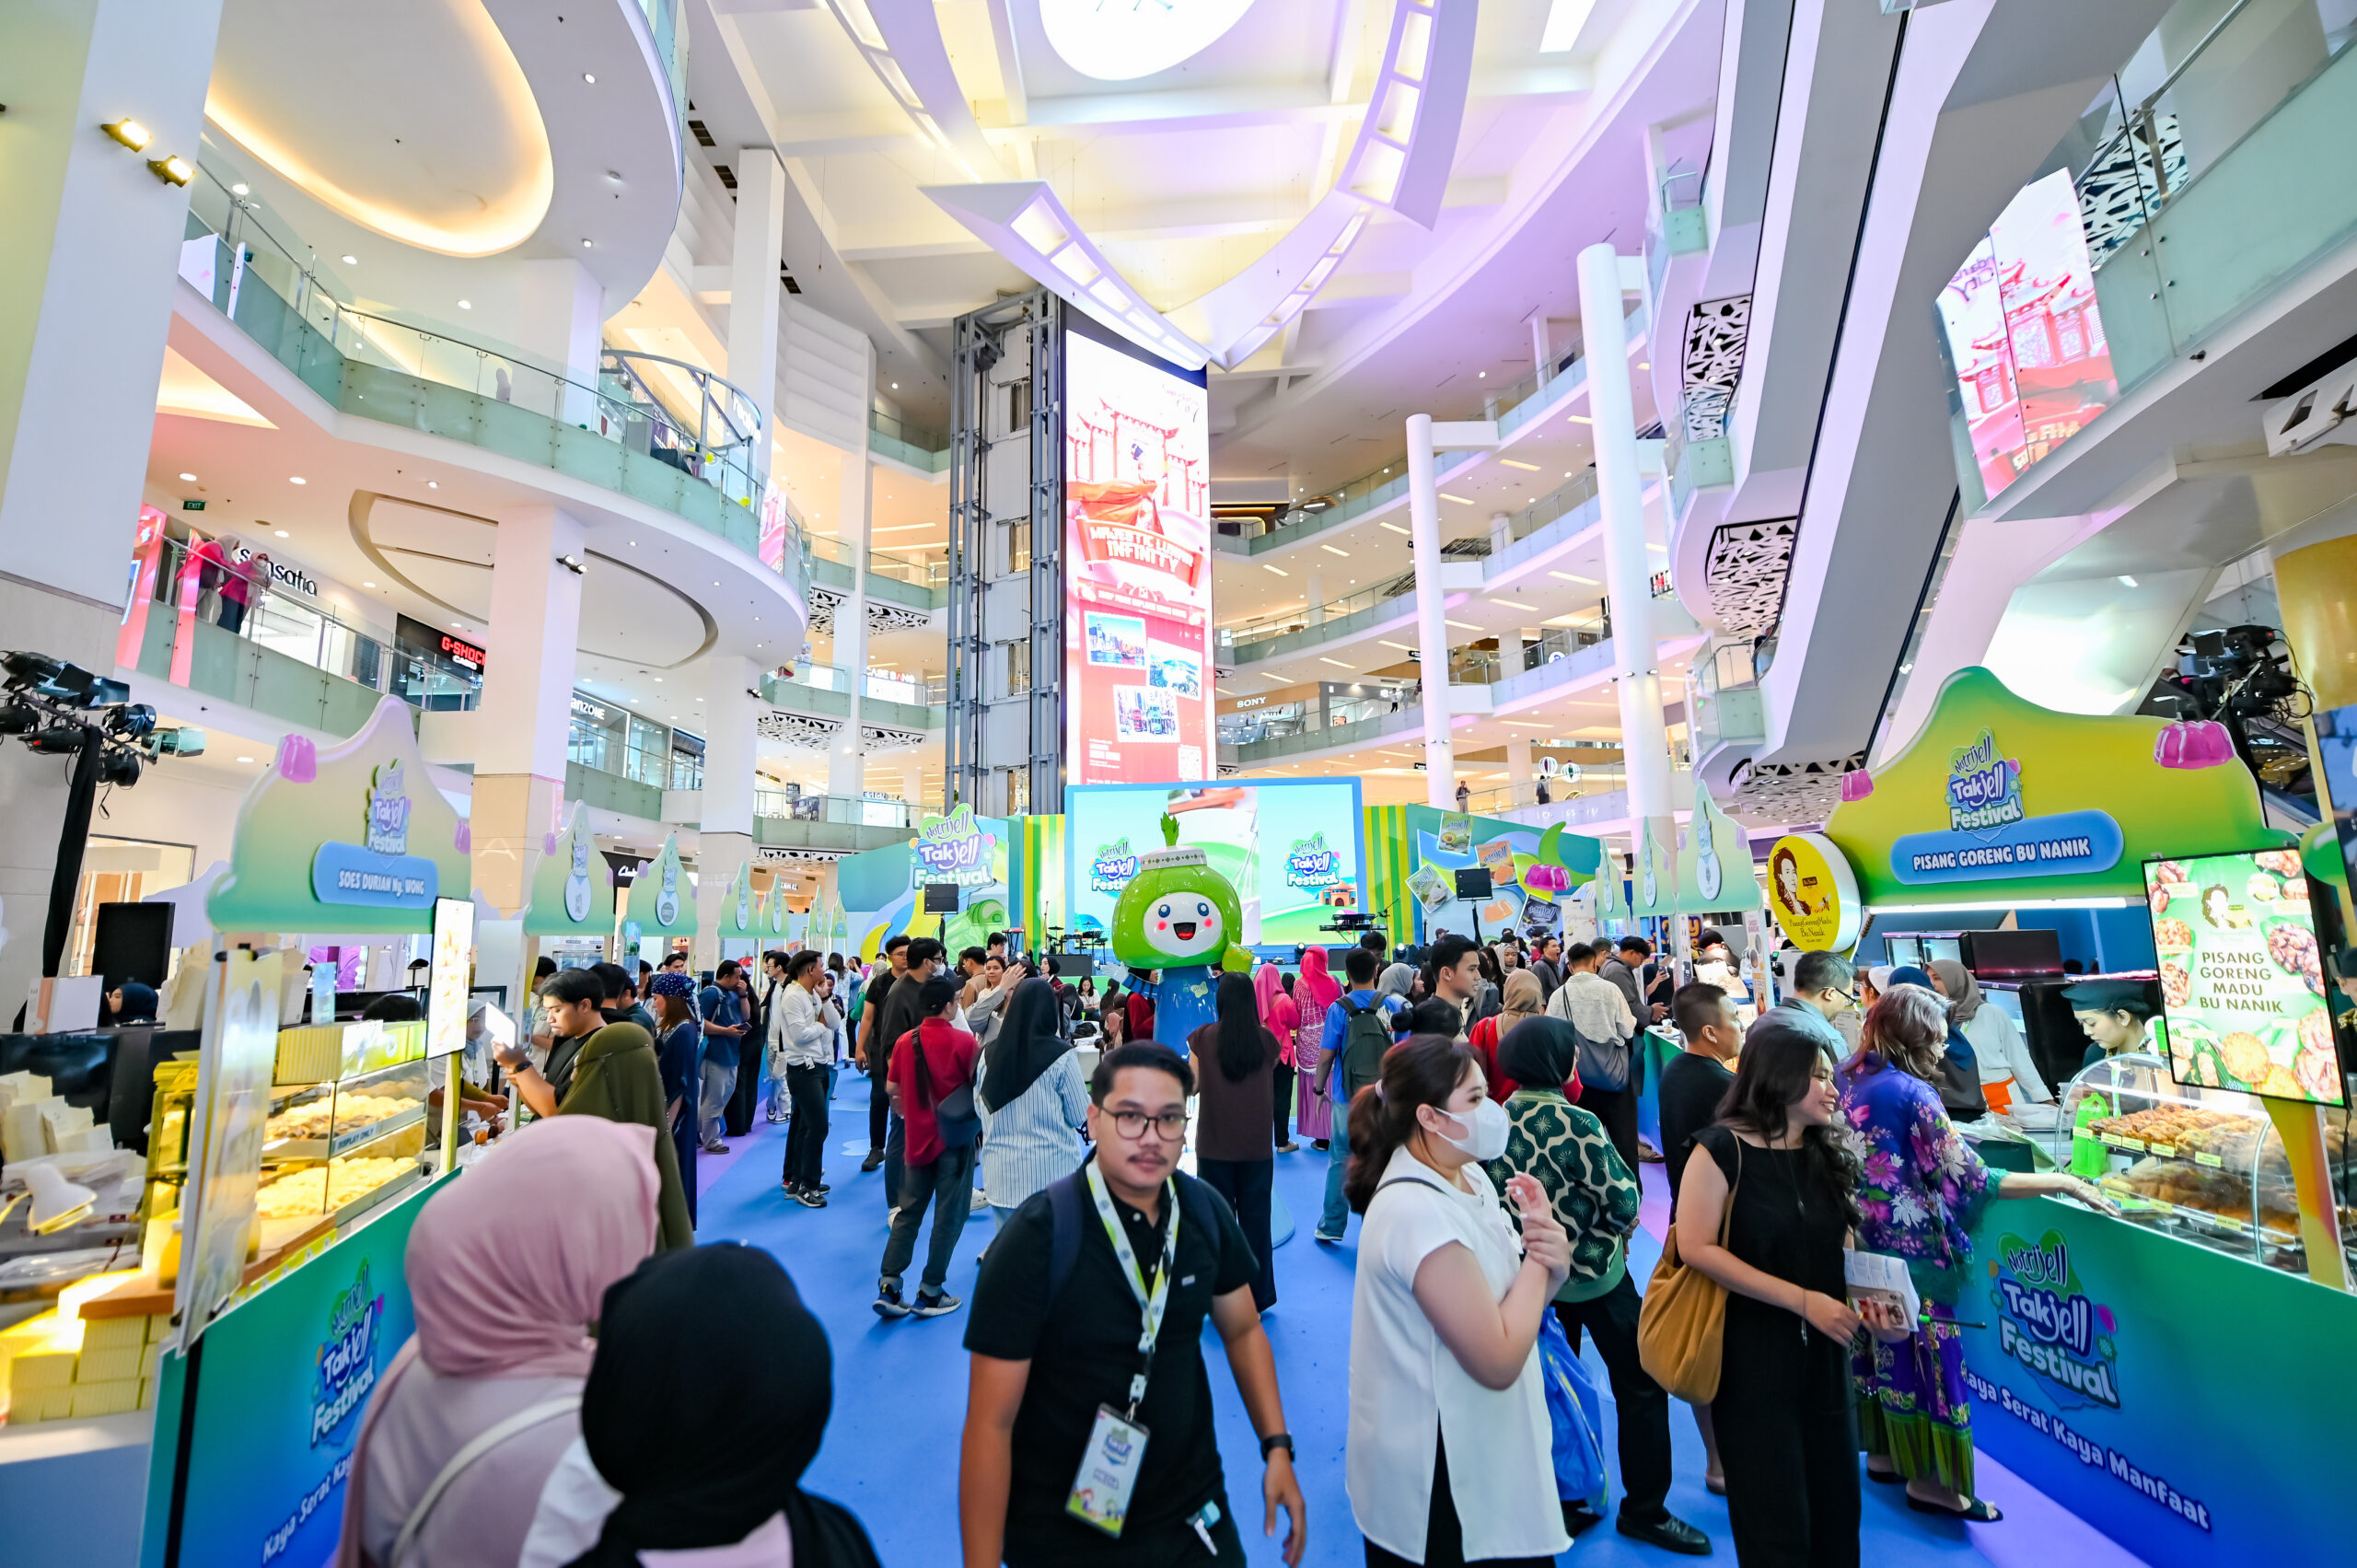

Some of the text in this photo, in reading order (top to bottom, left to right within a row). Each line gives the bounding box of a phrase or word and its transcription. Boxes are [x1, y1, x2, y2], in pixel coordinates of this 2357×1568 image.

[238, 548, 318, 597] ssatia
[1107, 540, 1178, 573] INFINITY
[571, 697, 605, 720] anZONE
[1237, 696, 1267, 708] SONY
[1955, 735, 1991, 772] Nutrijell
[1951, 763, 2003, 807] Takjell
[375, 798, 404, 831] Takjell
[926, 810, 969, 839] Nutrijell
[1951, 797, 2023, 829] Festival
[368, 827, 405, 853] Festival
[920, 835, 980, 869] Takjell
[1913, 838, 2091, 871] PISANG GORENG BU NANIK
[914, 865, 993, 888] Festival
[1096, 856, 1134, 878] Takjell
[1287, 871, 1339, 886] Festival
[1291, 852, 1329, 874] Takjell
[339, 870, 361, 889] SOES
[362, 873, 390, 891] DURIAN
[404, 878, 424, 894] WONG
[1092, 877, 1125, 891] Festi
[2200, 967, 2271, 981] GORENG
[2202, 952, 2264, 964] PISANG
[2200, 996, 2283, 1013] BU NANIK
[2213, 982, 2263, 995] MADU
[2007, 1245, 2067, 1286] Nutrijell
[2003, 1283, 2087, 1353] Takjell
[324, 1305, 372, 1388] Takjell
[2001, 1318, 2117, 1404] Festival
[312, 1357, 374, 1443] Festival
[1966, 1372, 2210, 1529] aya Serat Kaya Manfaat
[263, 1453, 354, 1564] Kaya Serat Kay
